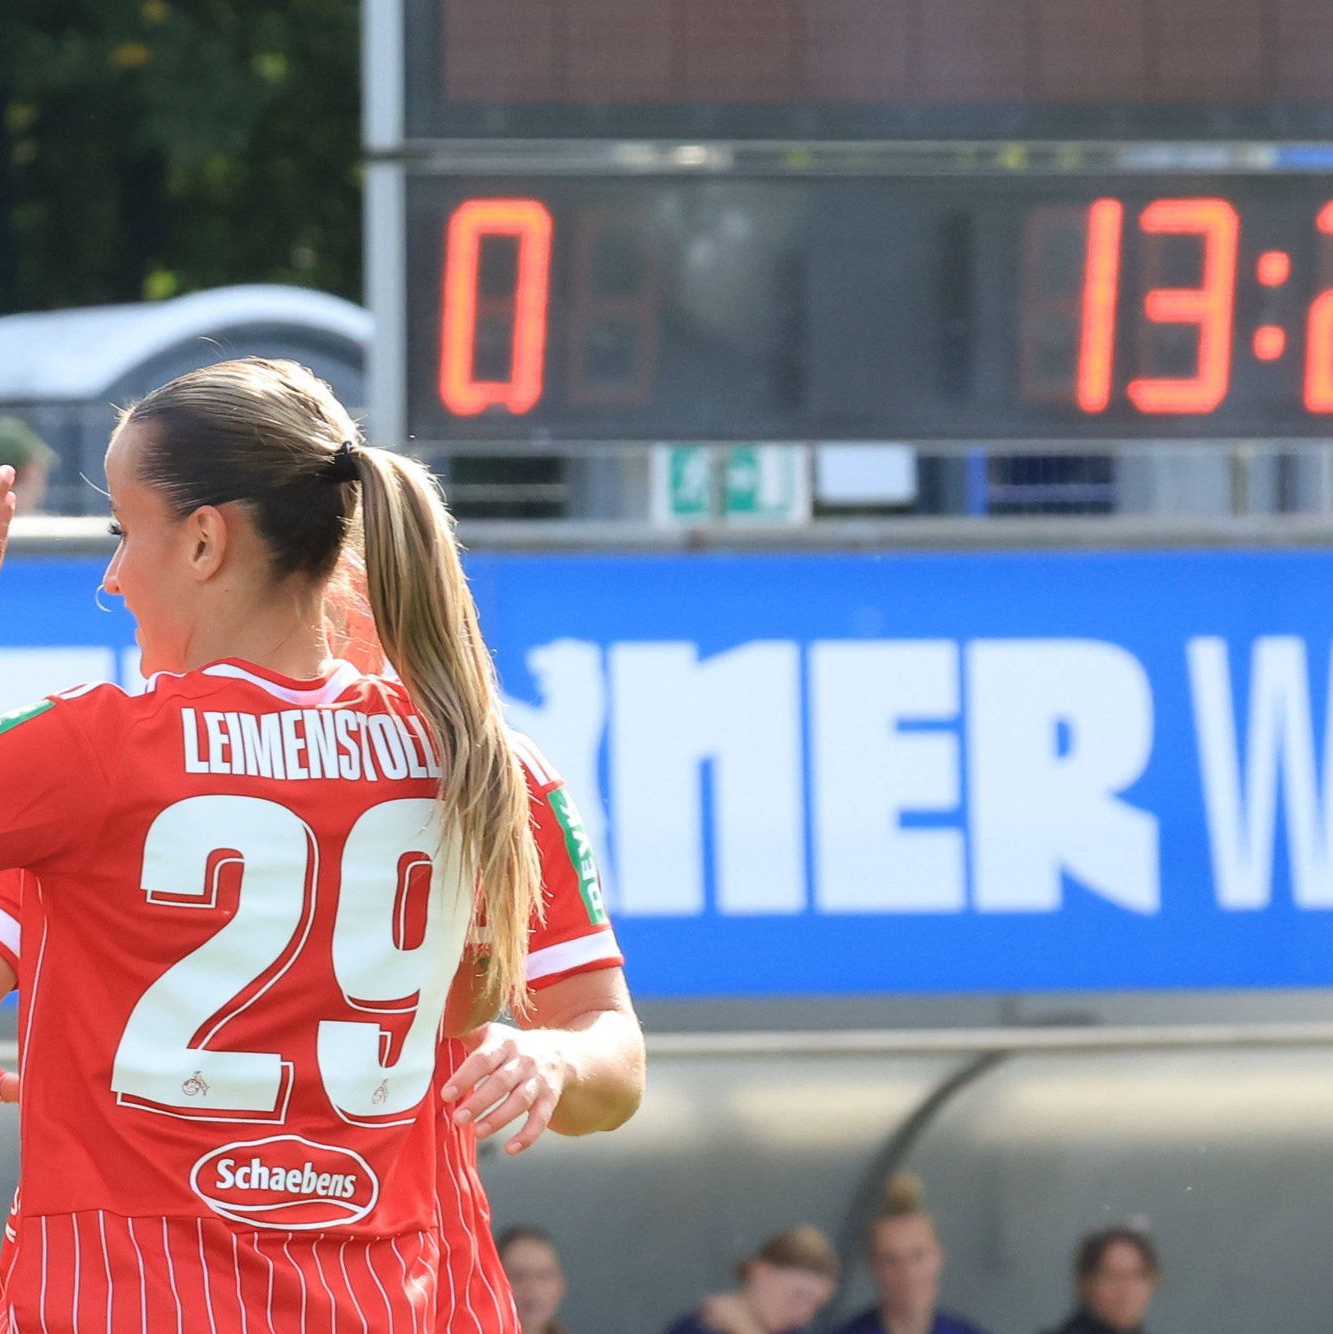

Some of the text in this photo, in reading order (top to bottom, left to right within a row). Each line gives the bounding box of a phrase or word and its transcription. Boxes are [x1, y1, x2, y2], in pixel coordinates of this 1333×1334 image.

[439, 198, 553, 416] 0
[1076, 197, 1333, 416] 13:
[111, 795, 479, 1127] 29
[215, 1157, 357, 1199] Schaebens
